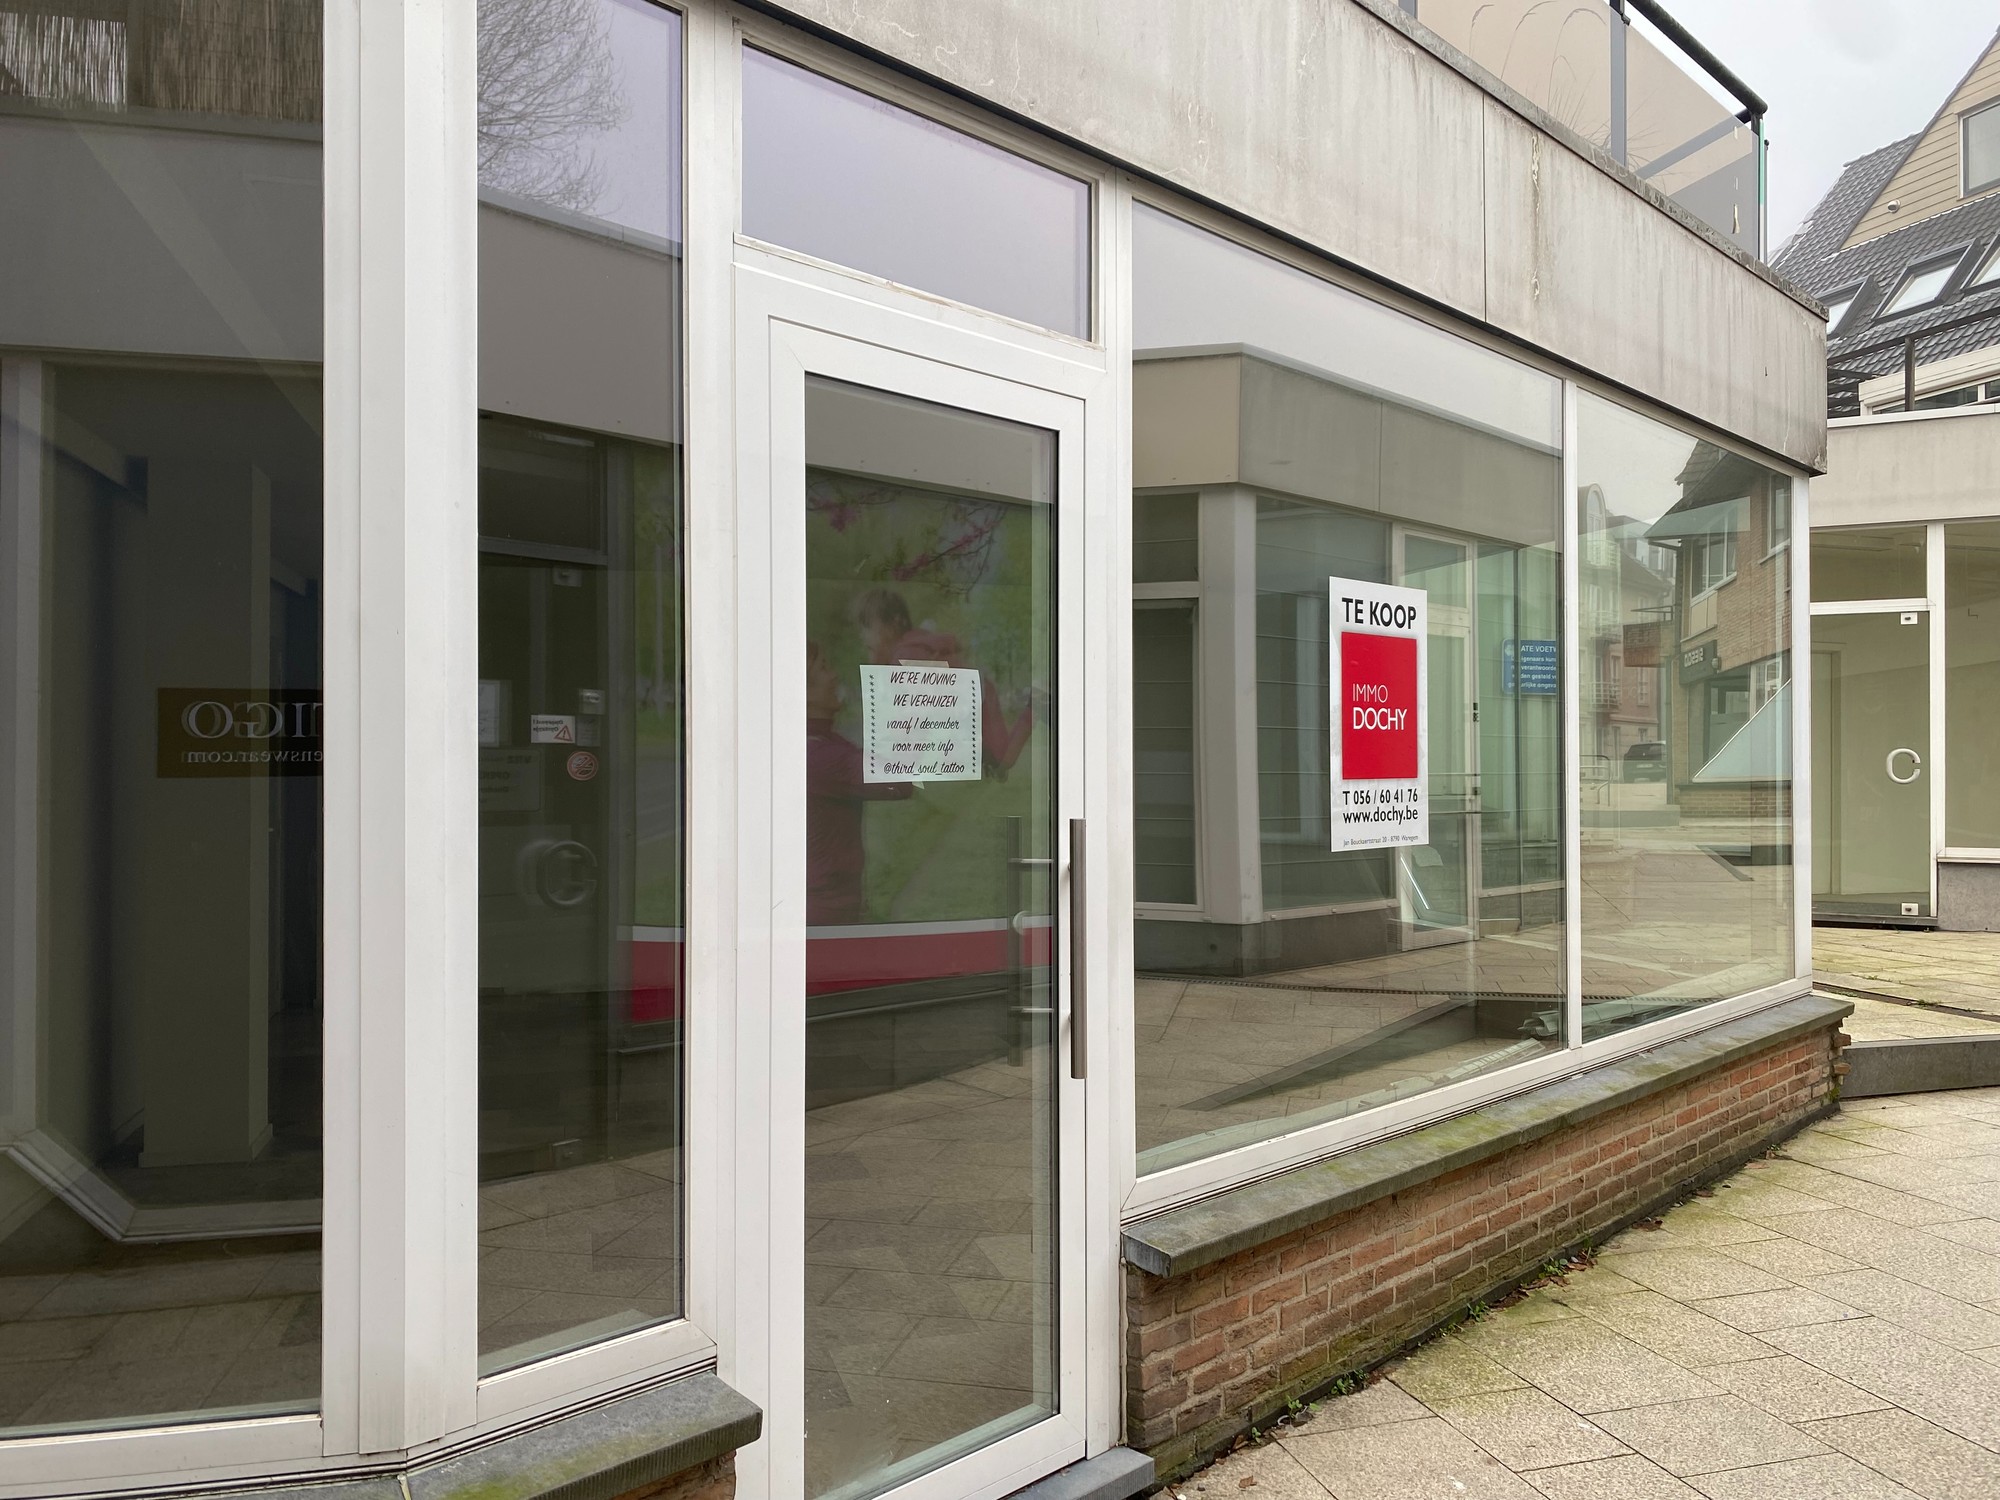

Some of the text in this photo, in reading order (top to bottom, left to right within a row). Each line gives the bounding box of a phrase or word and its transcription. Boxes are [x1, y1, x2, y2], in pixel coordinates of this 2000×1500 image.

[1342, 597, 1417, 629] TE KOOP
[890, 671, 957, 686] WE'RE MOVING
[893, 693, 959, 708] WE VERHUIZEN
[1352, 684, 1388, 703] IMMO
[886, 717, 913, 734] vanaf
[920, 717, 960, 730] december
[1352, 707, 1408, 731] DOCHY
[892, 739, 954, 756] voor meer info
[883, 761, 965, 776] @third_soul_tattoo
[1342, 791, 1350, 805] T
[1353, 790, 1371, 805] 056
[1379, 789, 1391, 804] 60
[1393, 789, 1404, 804] 41
[1407, 788, 1418, 803] 76
[1343, 805, 1419, 825] www.dochy.be
